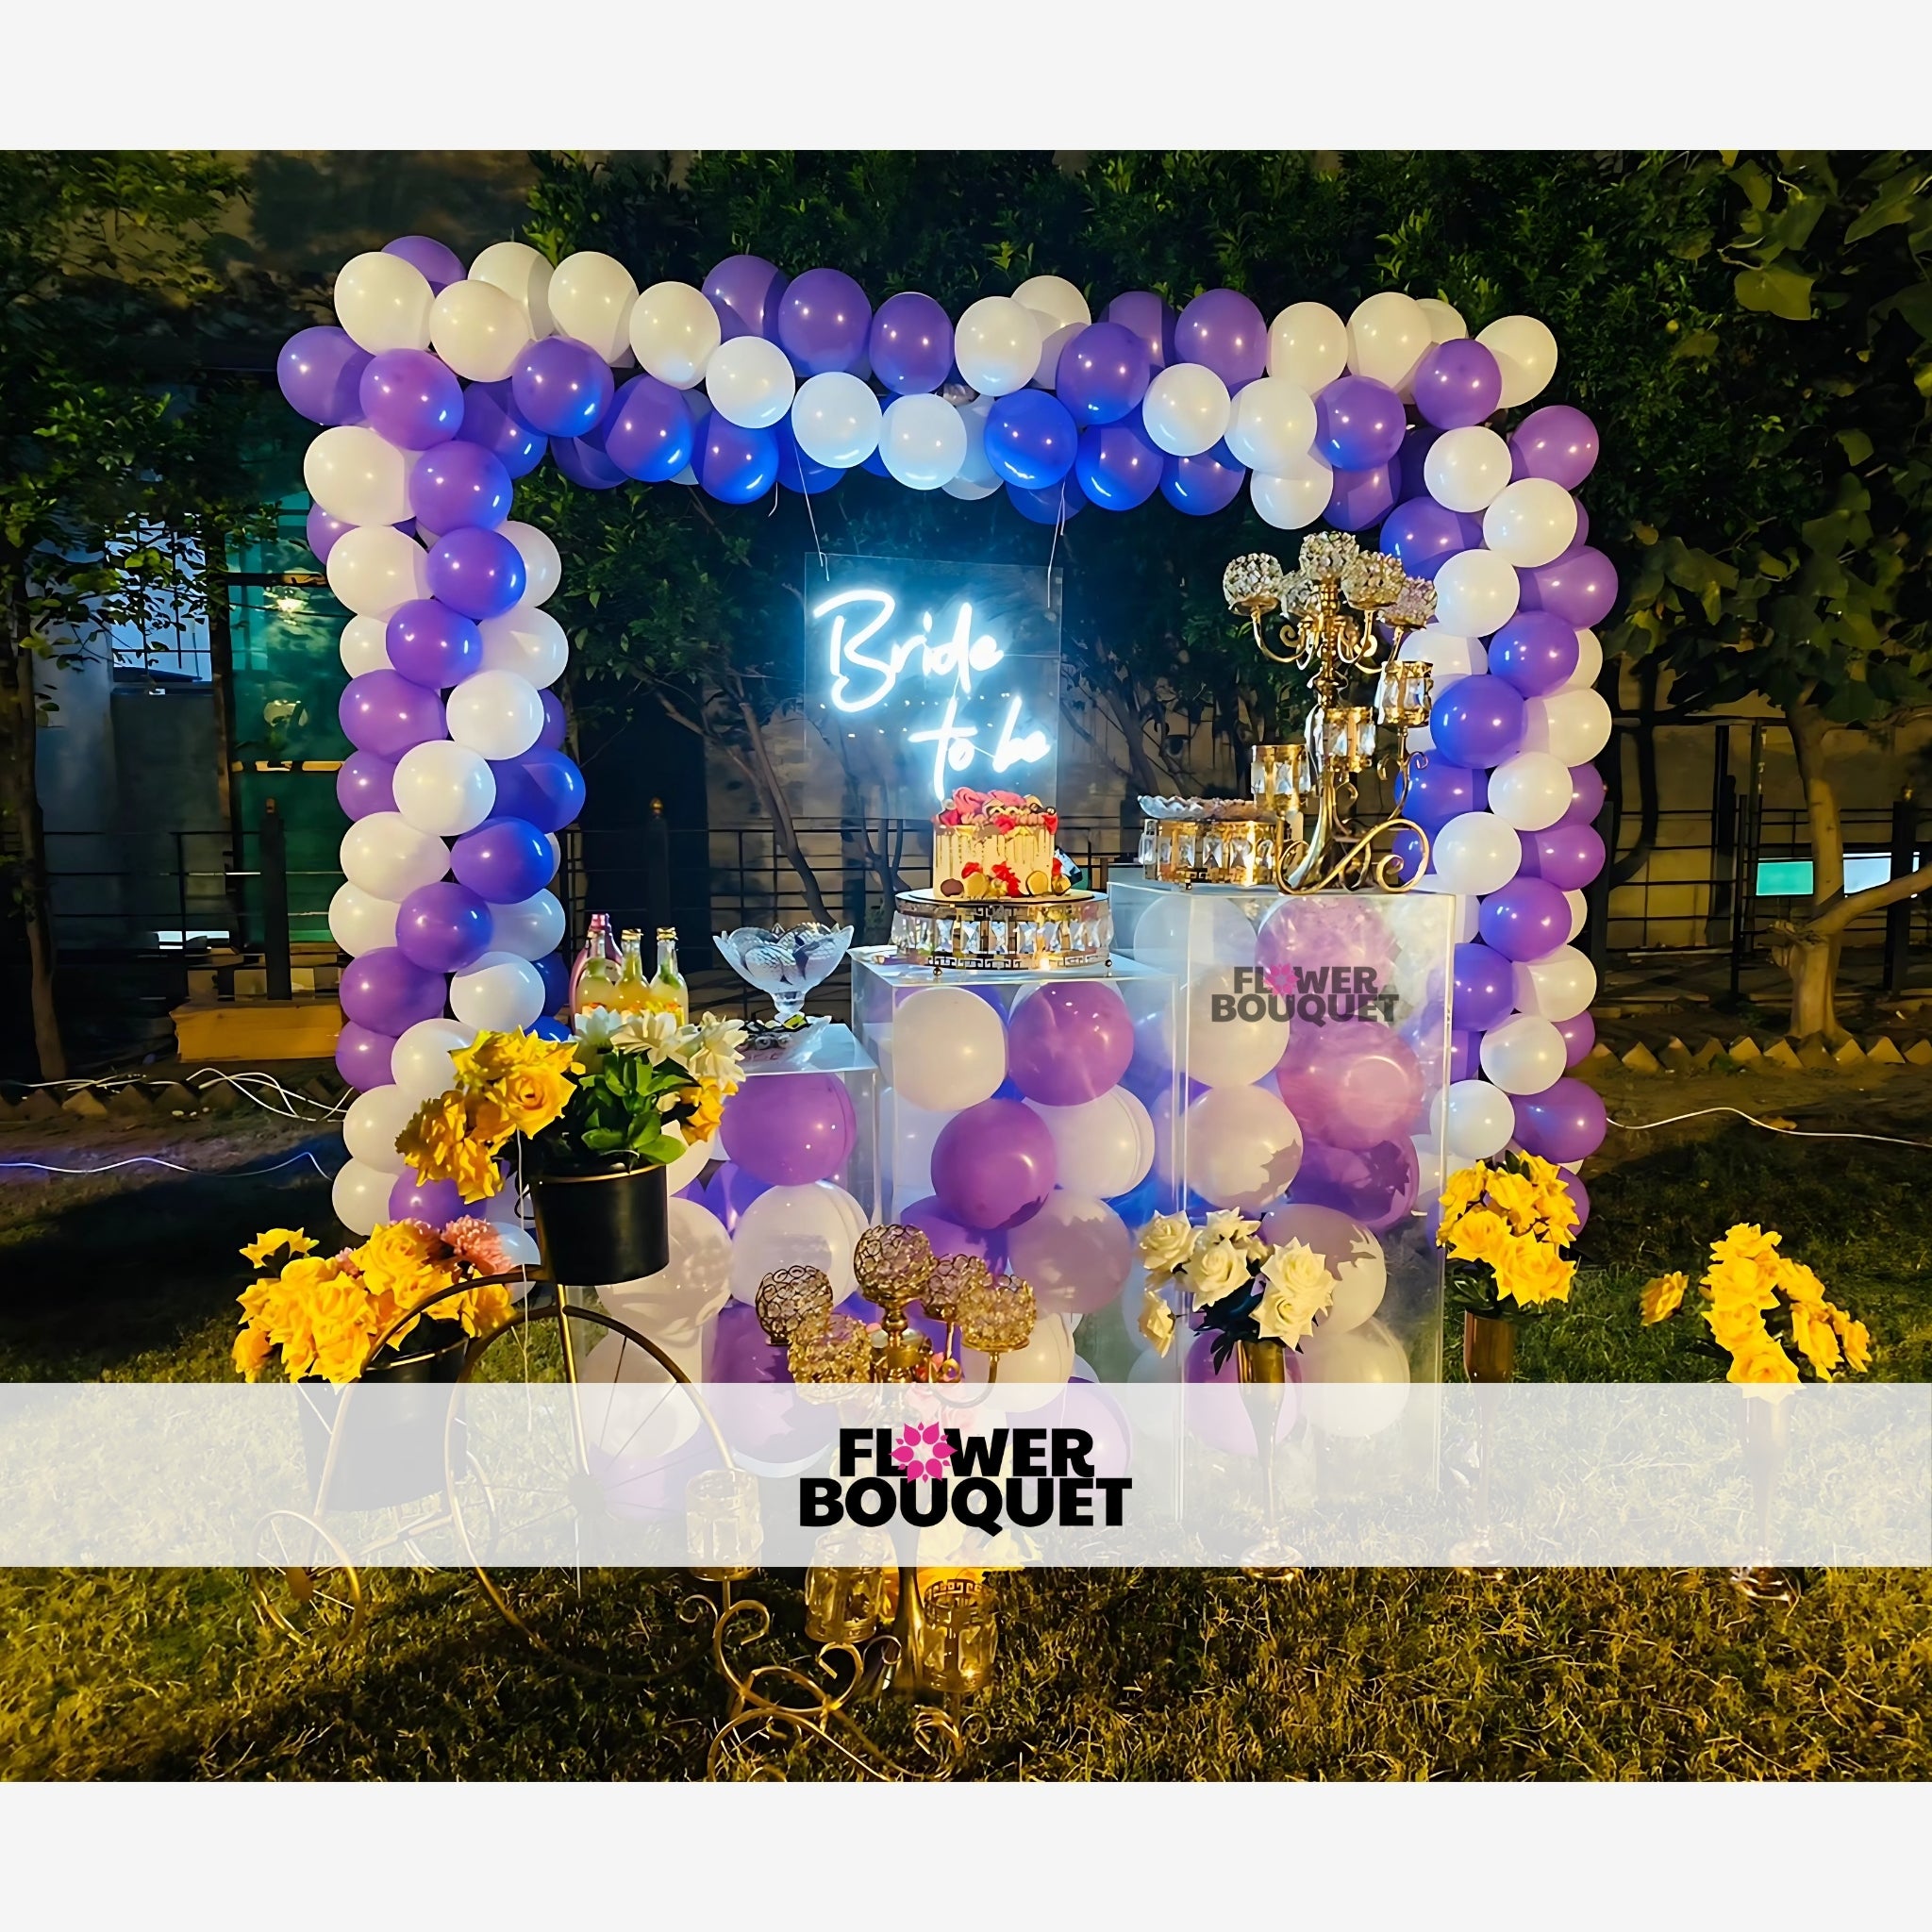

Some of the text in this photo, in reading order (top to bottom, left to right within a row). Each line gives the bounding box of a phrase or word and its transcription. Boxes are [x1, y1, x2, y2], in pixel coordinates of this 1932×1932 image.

[812, 589, 1005, 713] Bride
[908, 695, 1052, 802] to be
